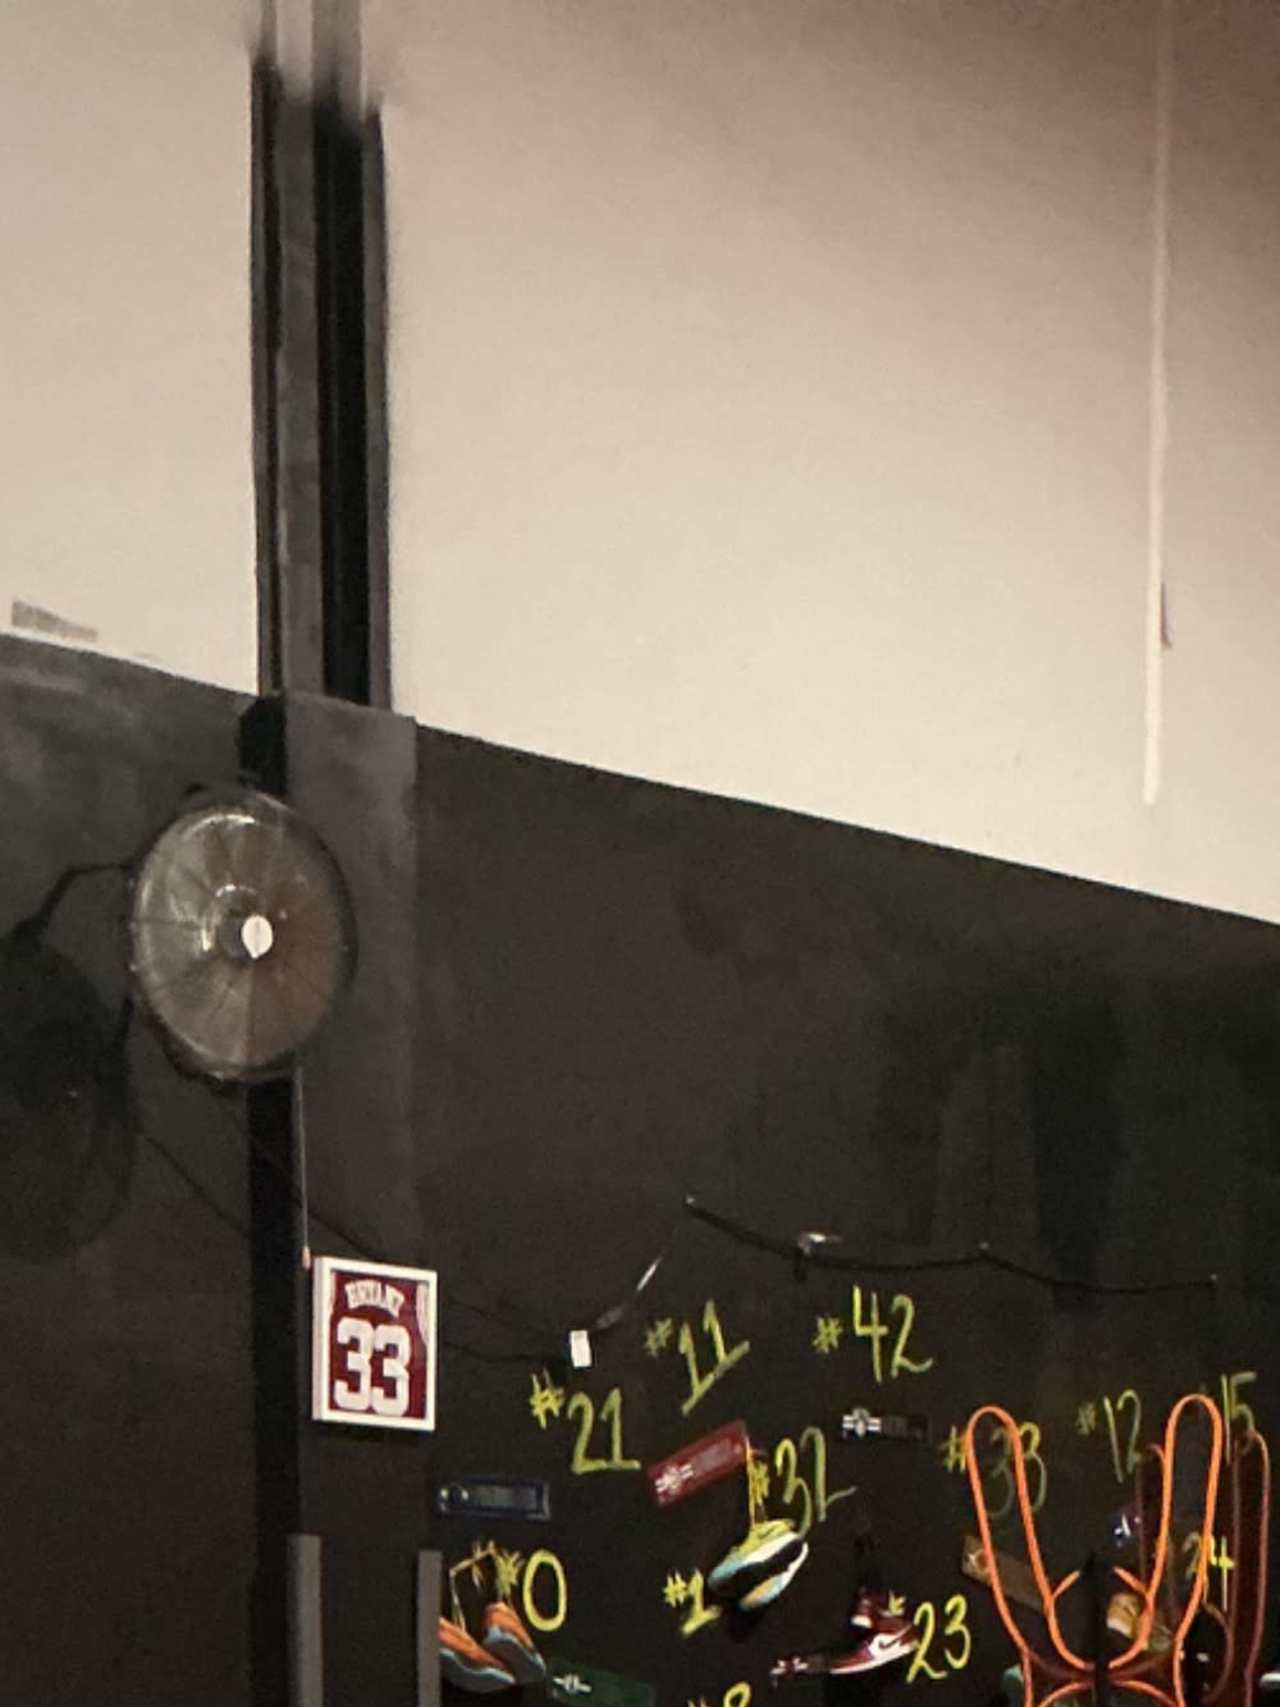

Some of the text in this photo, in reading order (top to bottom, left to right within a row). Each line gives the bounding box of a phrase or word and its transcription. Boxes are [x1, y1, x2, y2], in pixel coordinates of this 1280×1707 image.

[333, 1316, 412, 1417] 33
[644, 1299, 751, 1416] #11
[811, 1284, 933, 1384] #42
[529, 1370, 641, 1475] #21
